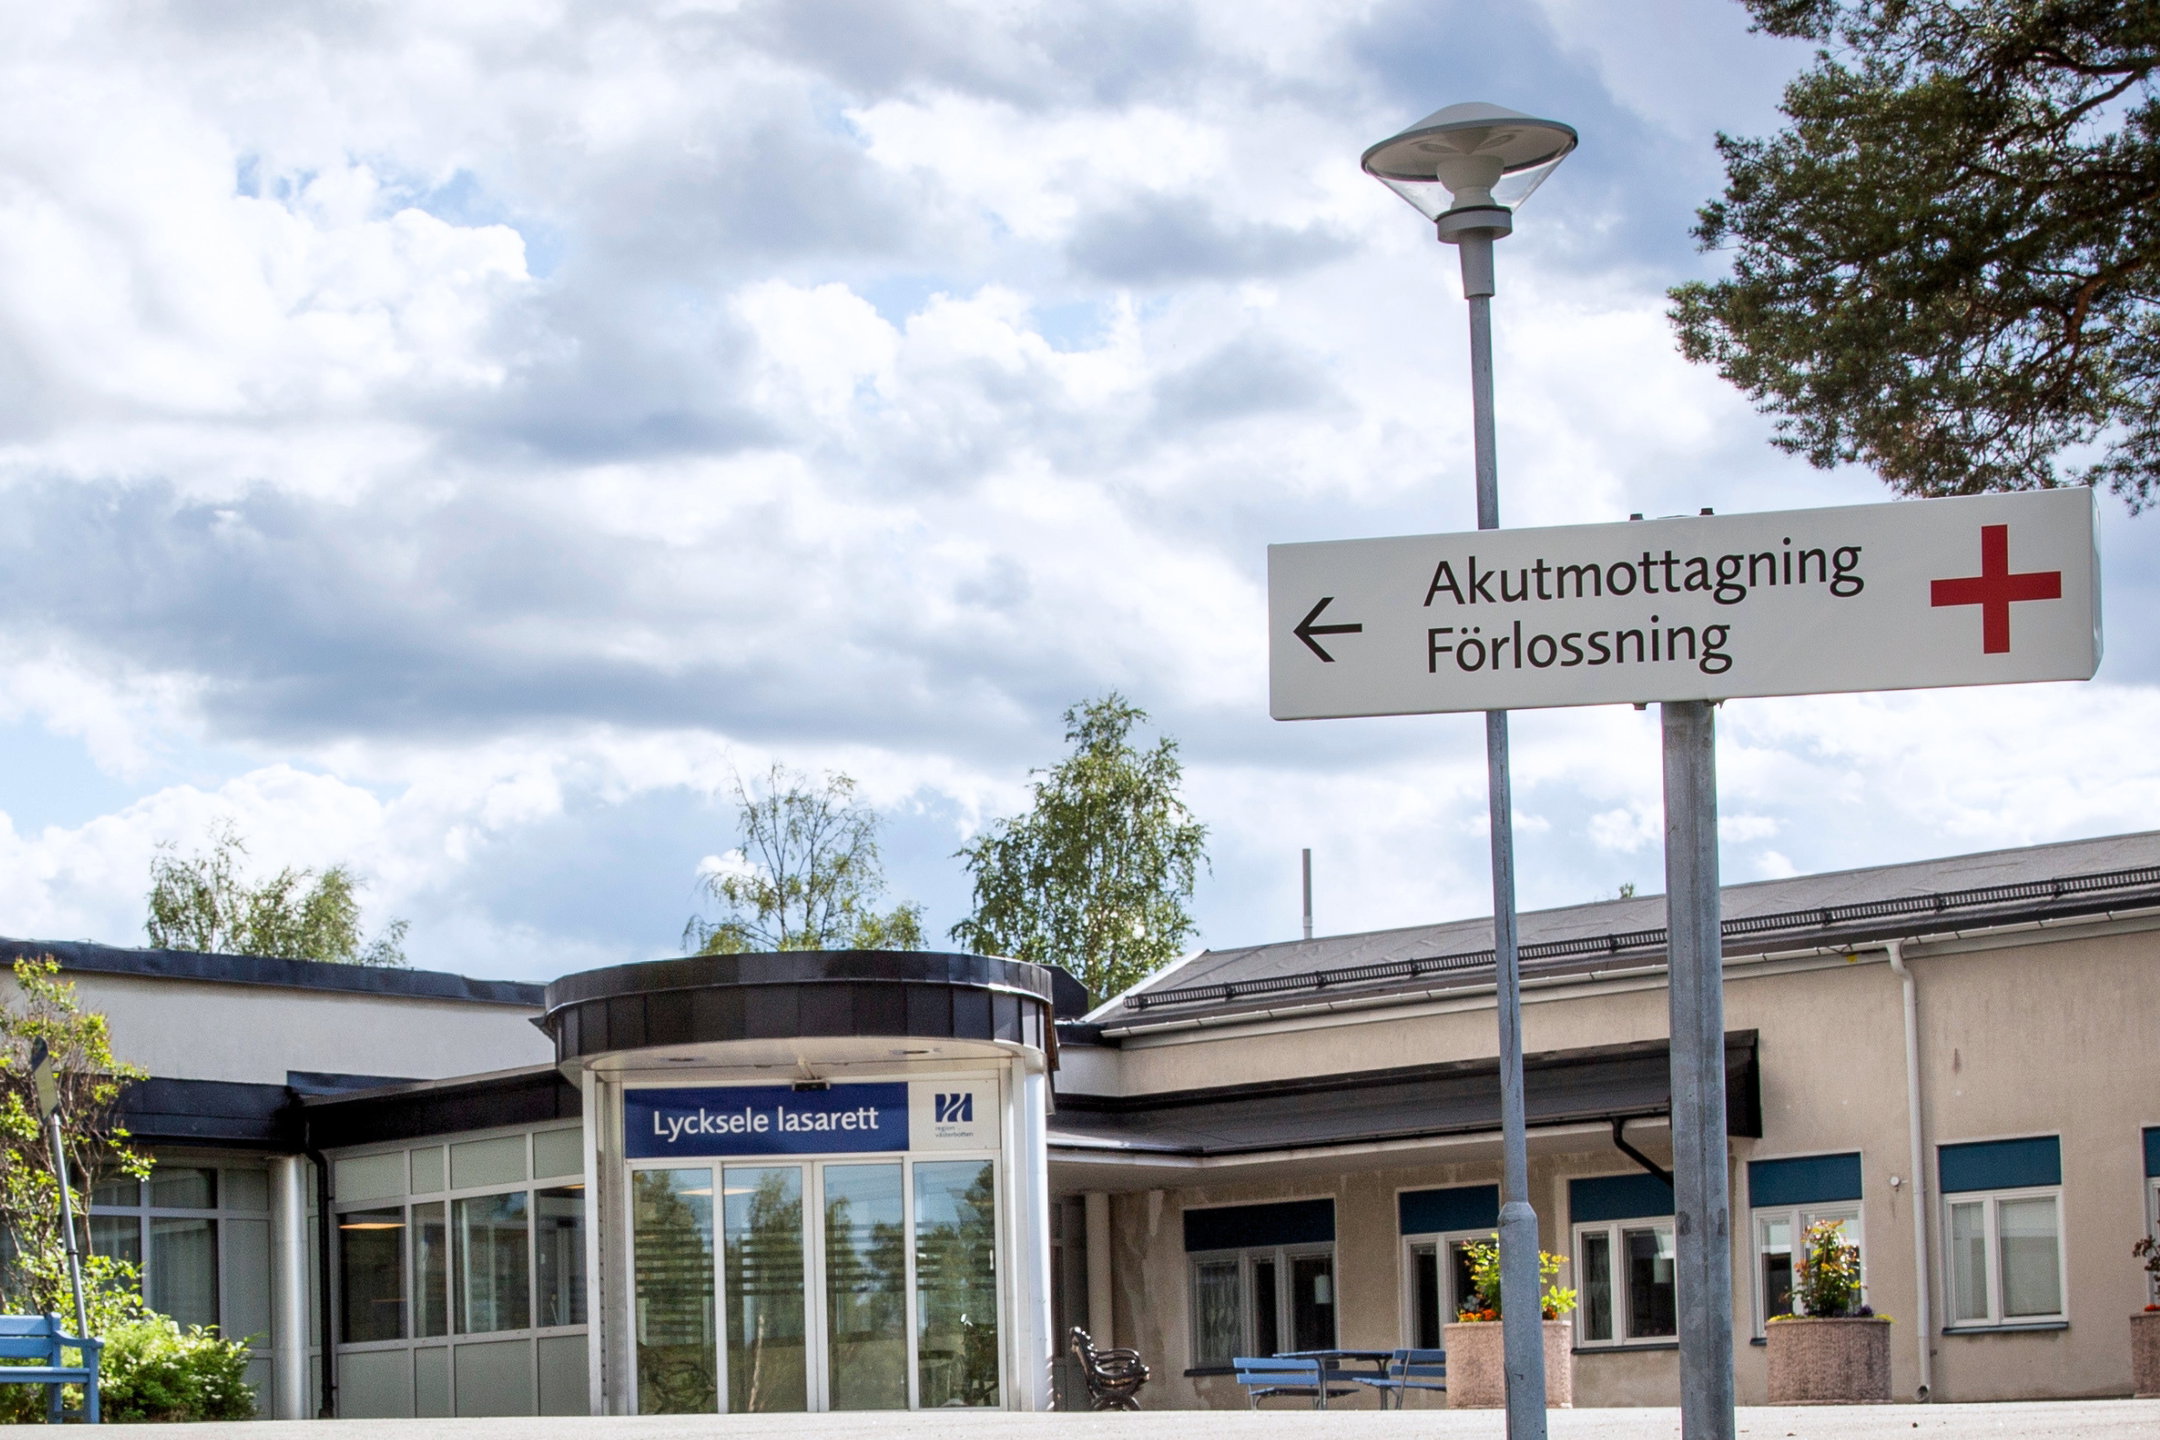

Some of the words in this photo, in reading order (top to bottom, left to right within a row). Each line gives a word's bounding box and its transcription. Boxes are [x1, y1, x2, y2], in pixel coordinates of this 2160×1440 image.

[1424, 537, 1865, 607] Akutmottagning
[1428, 614, 1733, 675] Förlossning
[653, 1107, 769, 1142] Lycksele
[778, 1106, 879, 1132] lasarett
